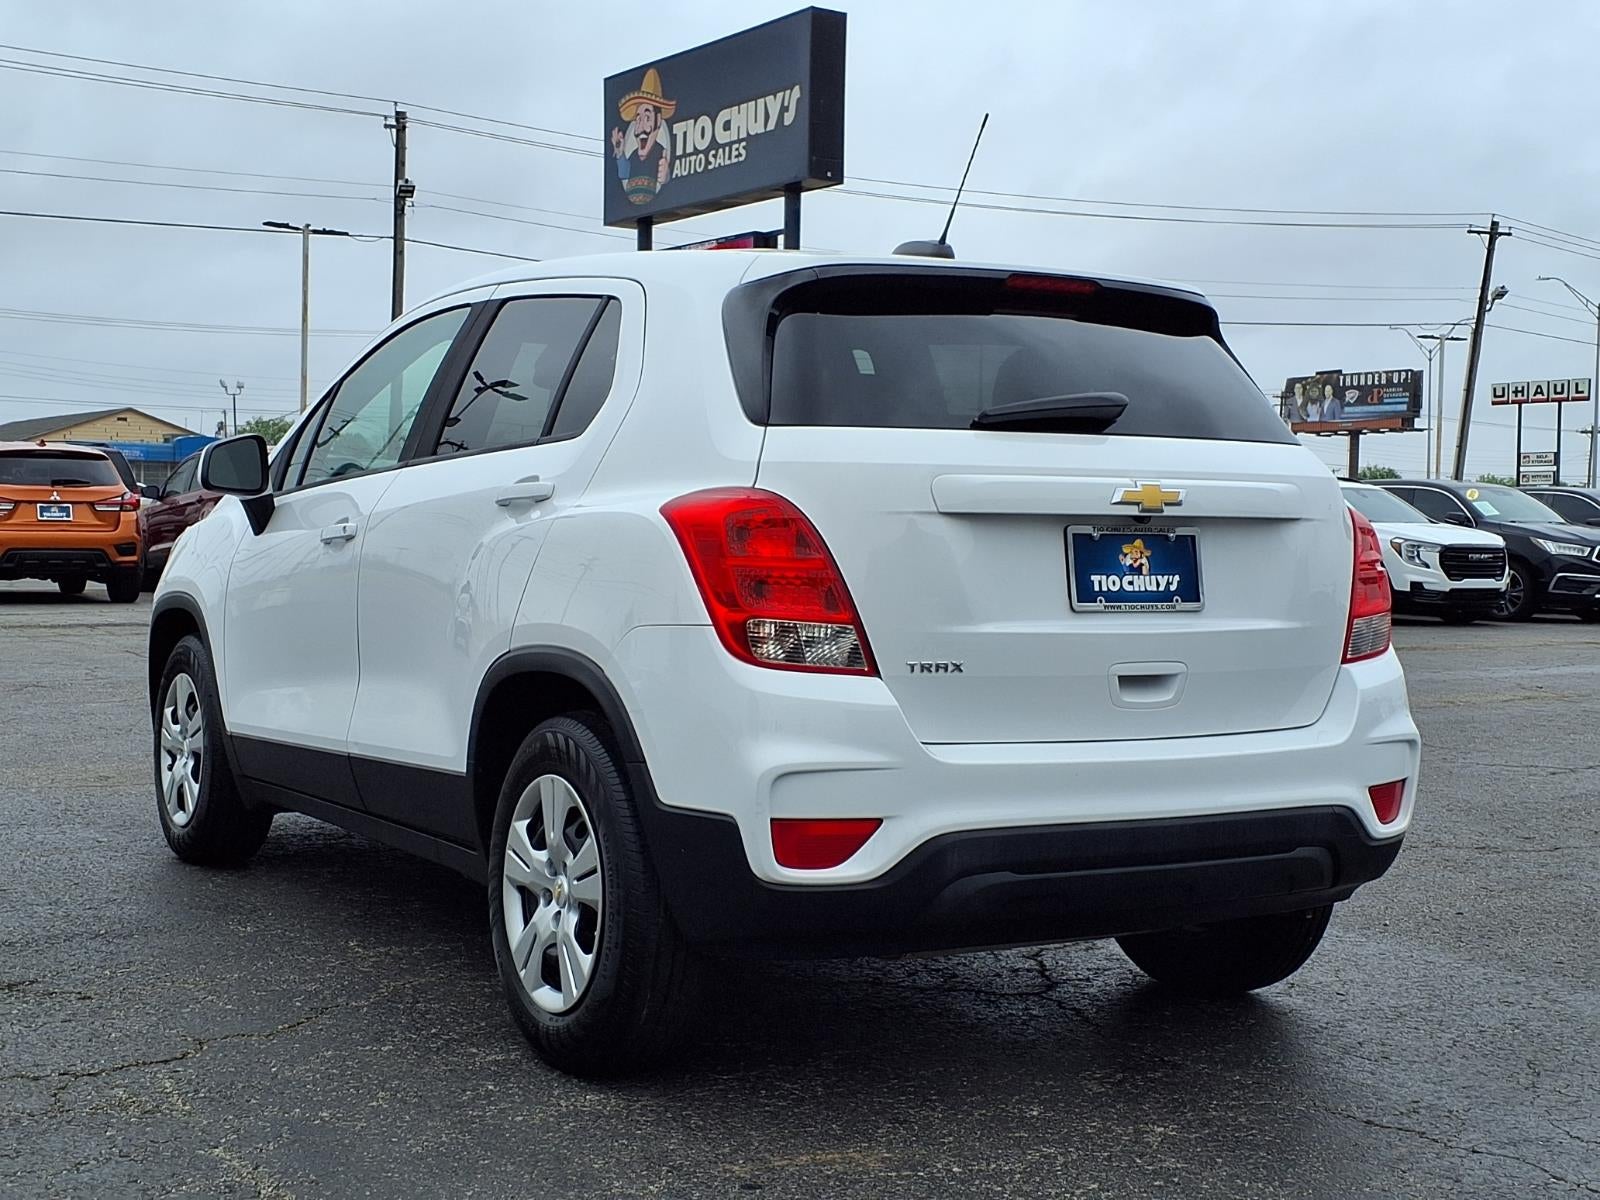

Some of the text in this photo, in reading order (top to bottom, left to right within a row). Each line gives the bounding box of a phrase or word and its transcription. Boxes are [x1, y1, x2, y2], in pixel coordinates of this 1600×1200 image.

[673, 85, 801, 156] TIO CHUY'S
[672, 141, 747, 179] AUTO SALES
[1339, 371, 1412, 387] THUNDER UP!
[1091, 574, 1180, 592] TIO CHUY'S
[906, 660, 964, 674] TRAX
